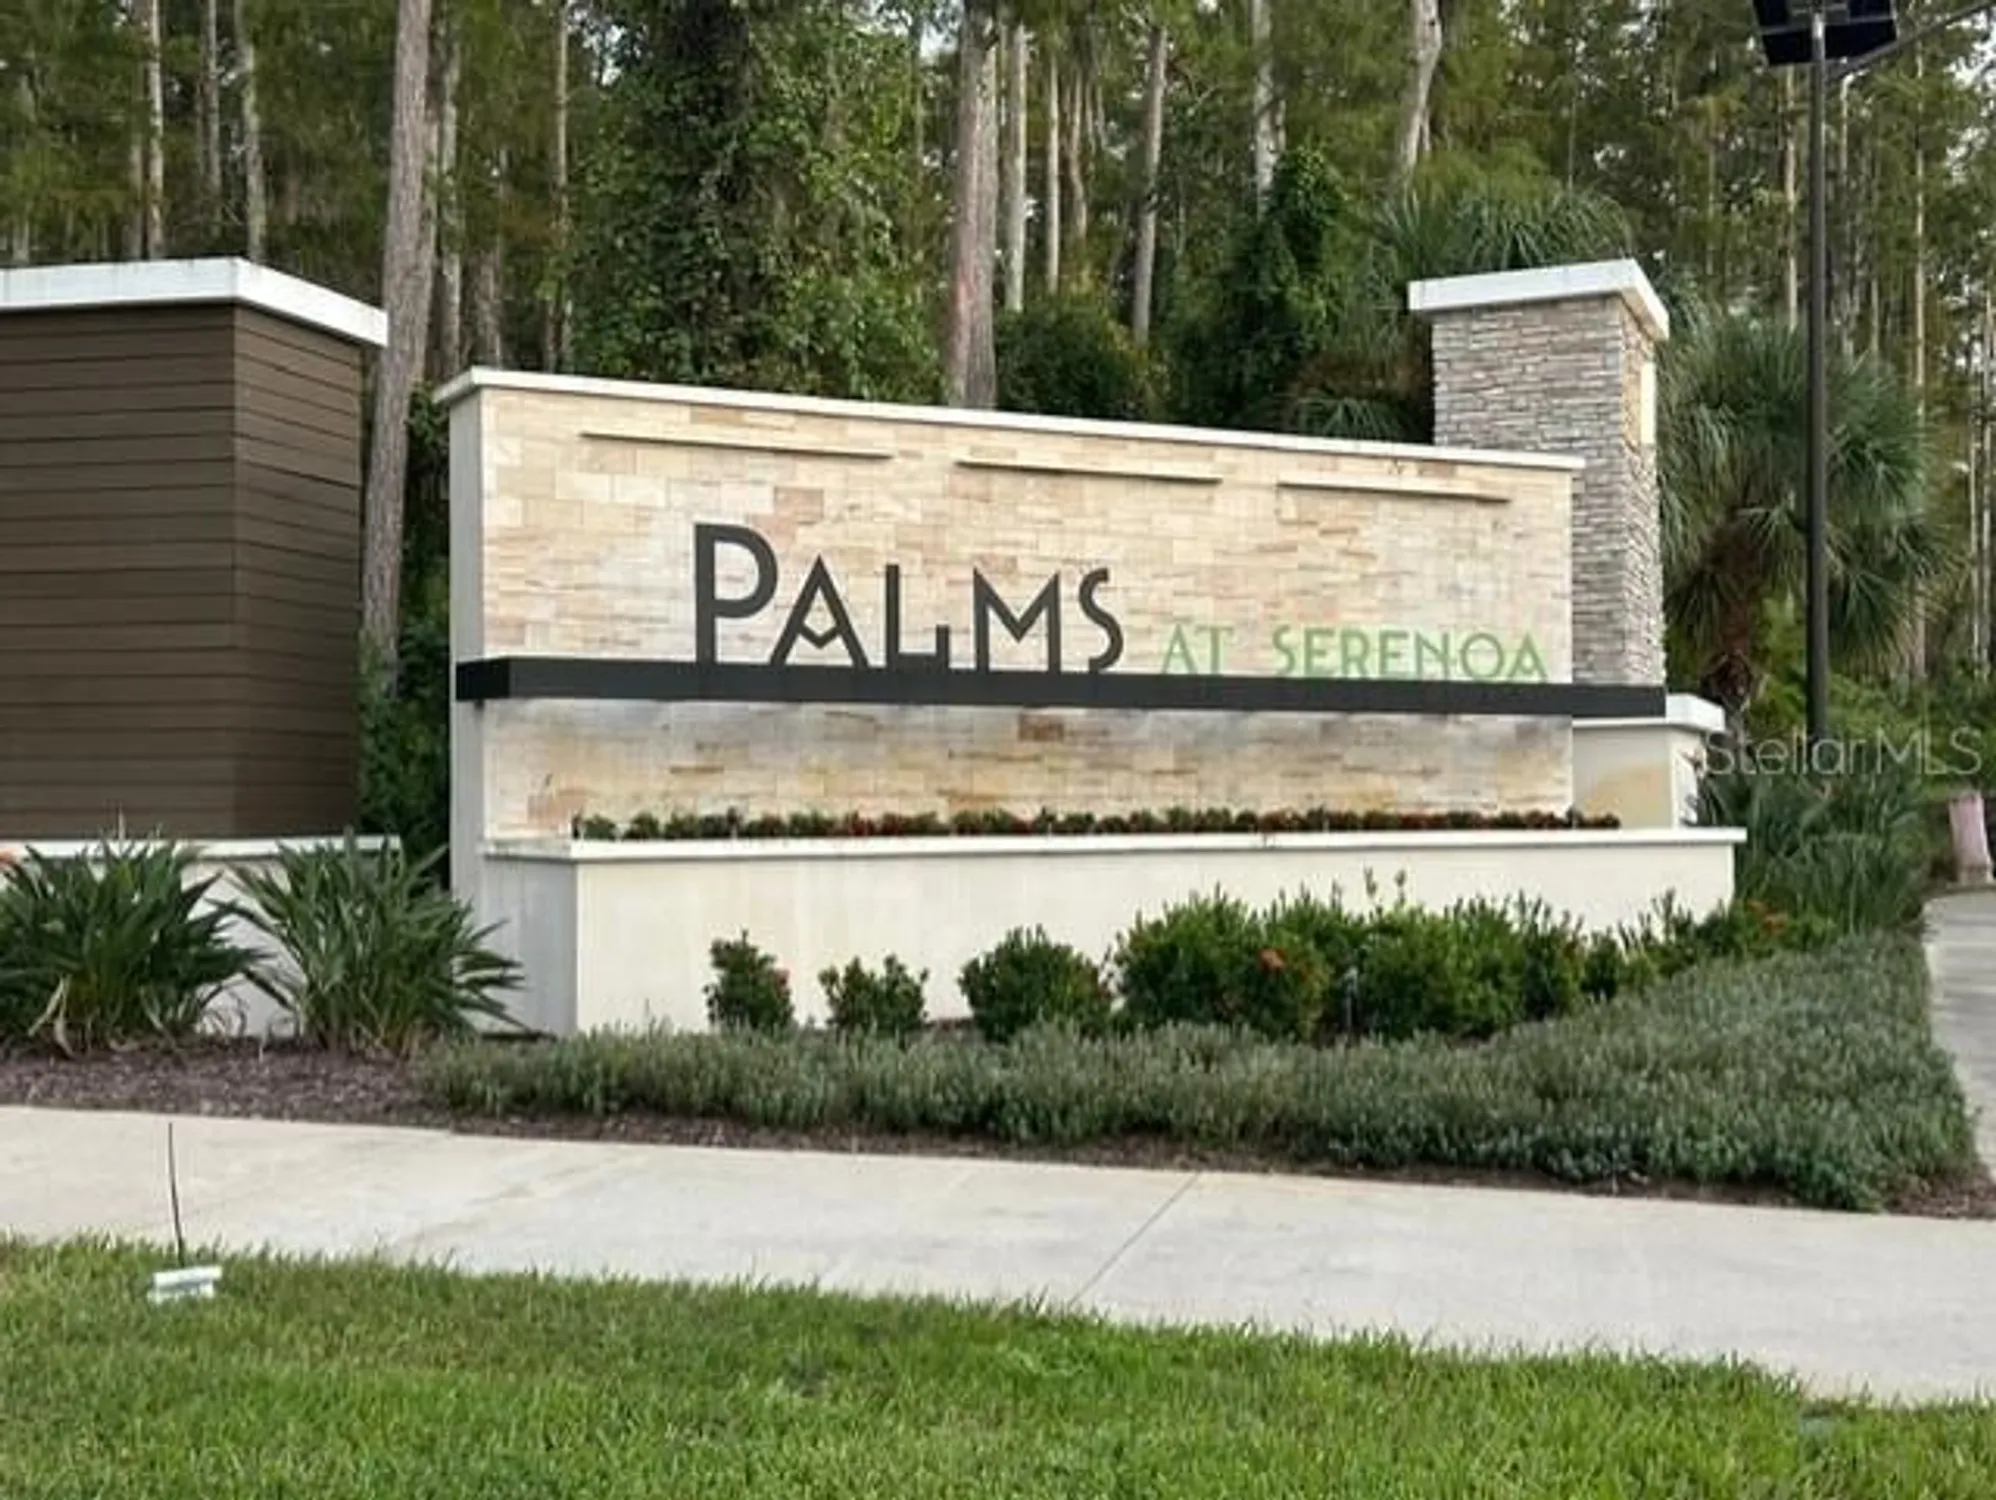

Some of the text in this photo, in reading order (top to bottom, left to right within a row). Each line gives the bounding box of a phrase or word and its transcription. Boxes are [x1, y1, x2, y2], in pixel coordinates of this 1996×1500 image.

[695, 523, 1548, 681] PALMS AT SERENOA
